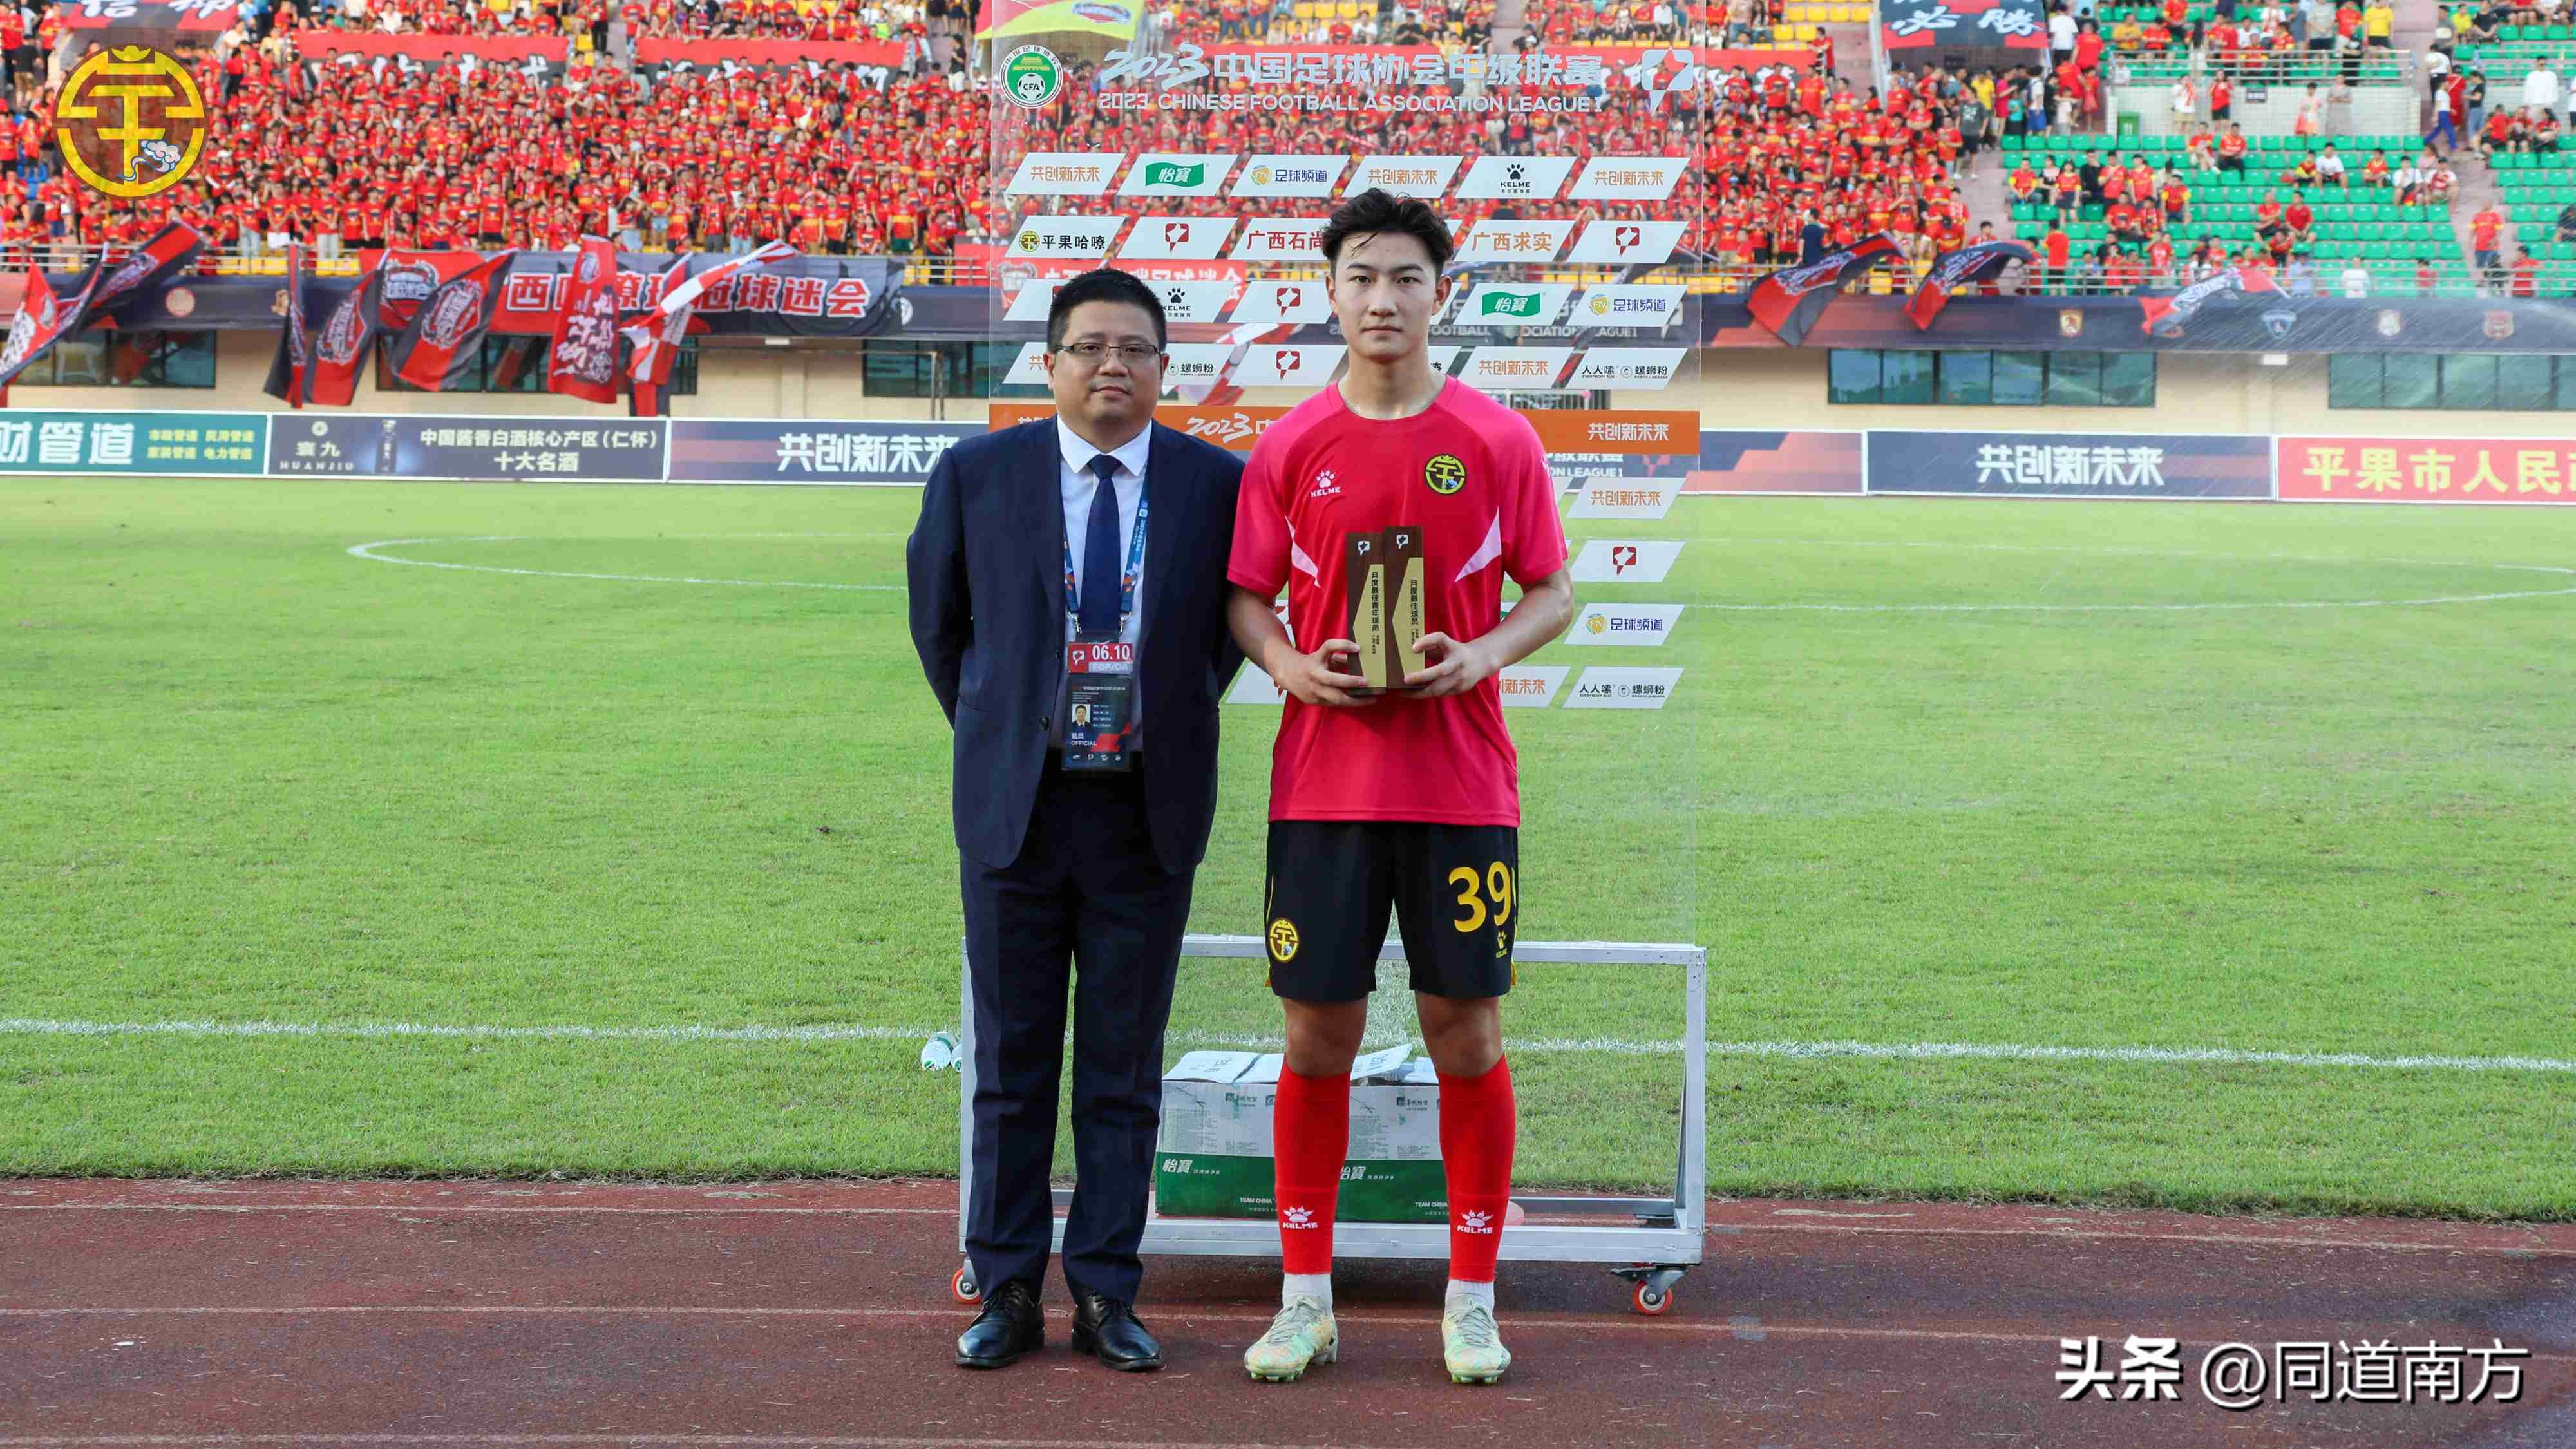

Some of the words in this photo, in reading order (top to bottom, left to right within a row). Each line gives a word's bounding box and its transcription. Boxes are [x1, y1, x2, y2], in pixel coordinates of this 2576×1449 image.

[1099, 93, 1149, 110] 2023
[1159, 93, 1248, 111] CHINESE
[1251, 95, 1359, 111] FOOTBALL
[1363, 95, 1504, 113] ASSOCIATION
[1030, 166, 1101, 182] 共创新未来
[1157, 165, 1191, 184] 怡寶
[1274, 169, 1327, 182] 足球频道
[1367, 168, 1438, 184] 共创新未来
[1594, 170, 1665, 186] 共创新未来
[1041, 234, 1106, 250] 平果哈嘹
[1472, 232, 1553, 251] 广西求实
[1494, 298, 1529, 312] 怡寶
[1613, 298, 1667, 312] 足球频道
[1478, 360, 1548, 375] 共创新未来
[1587, 422, 1669, 441] 共创新未来
[279, 461, 355, 471] HUANJIU
[494, 451, 580, 472] 十大名酒
[1976, 444, 2164, 487] 共创新未来
[2302, 447, 2576, 495] 平果市人民
[1311, 486, 1341, 498] KELME
[1590, 489, 1661, 506] 共创新未来
[1610, 618, 1663, 631] 足球频道
[1092, 645, 1130, 661] 06.10
[1448, 860, 1512, 933] 39
[1162, 1159, 1193, 1173] 怡寶
[1457, 1225, 1493, 1235] KELME
